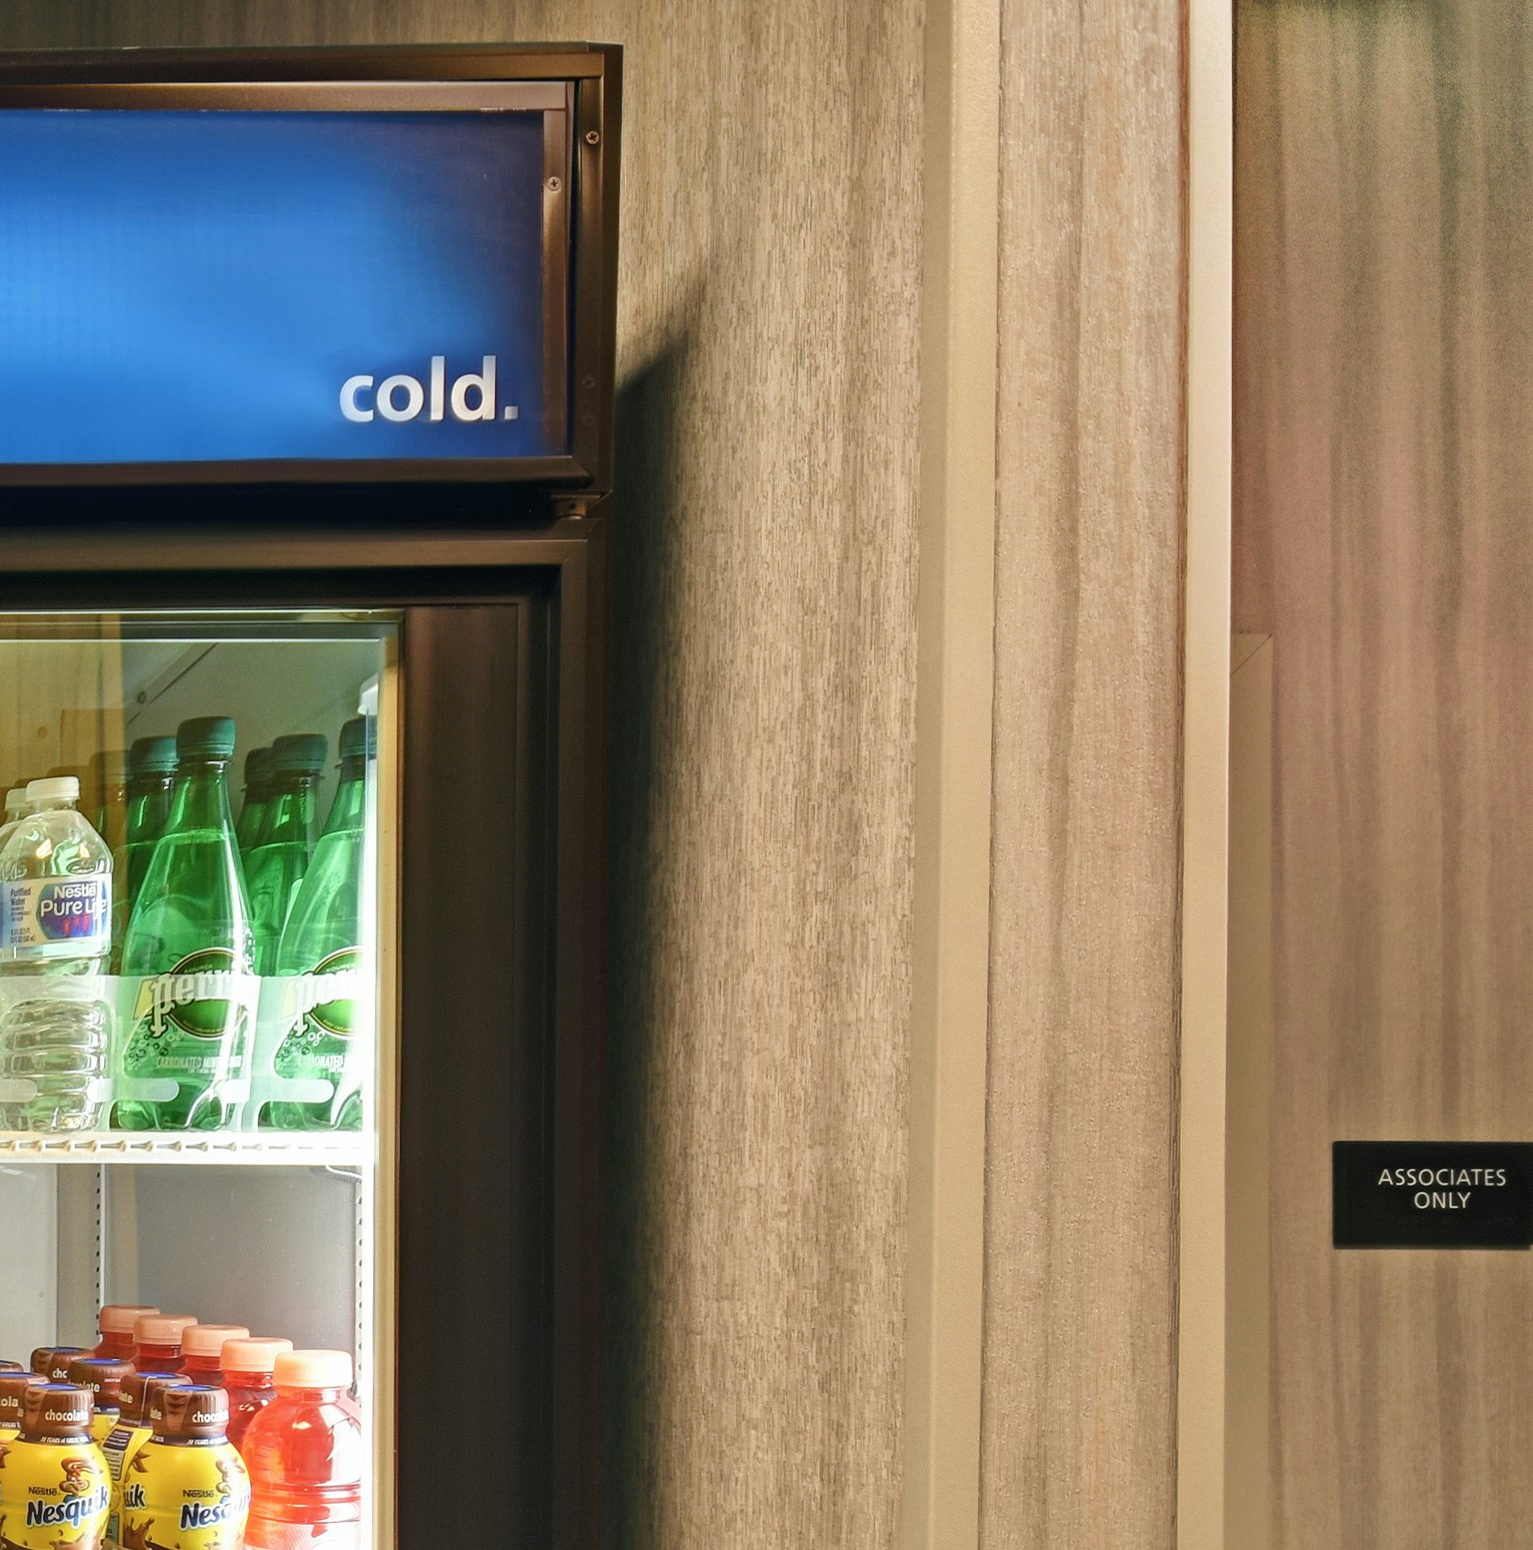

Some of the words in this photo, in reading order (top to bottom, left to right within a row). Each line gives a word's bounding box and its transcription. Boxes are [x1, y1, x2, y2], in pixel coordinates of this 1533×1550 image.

[340, 355, 518, 422] cold.
[1378, 1169, 1506, 1186] ASSOCIATES
[1414, 1192, 1471, 1209] ONLY
[27, 1491, 109, 1527] Nesquik
